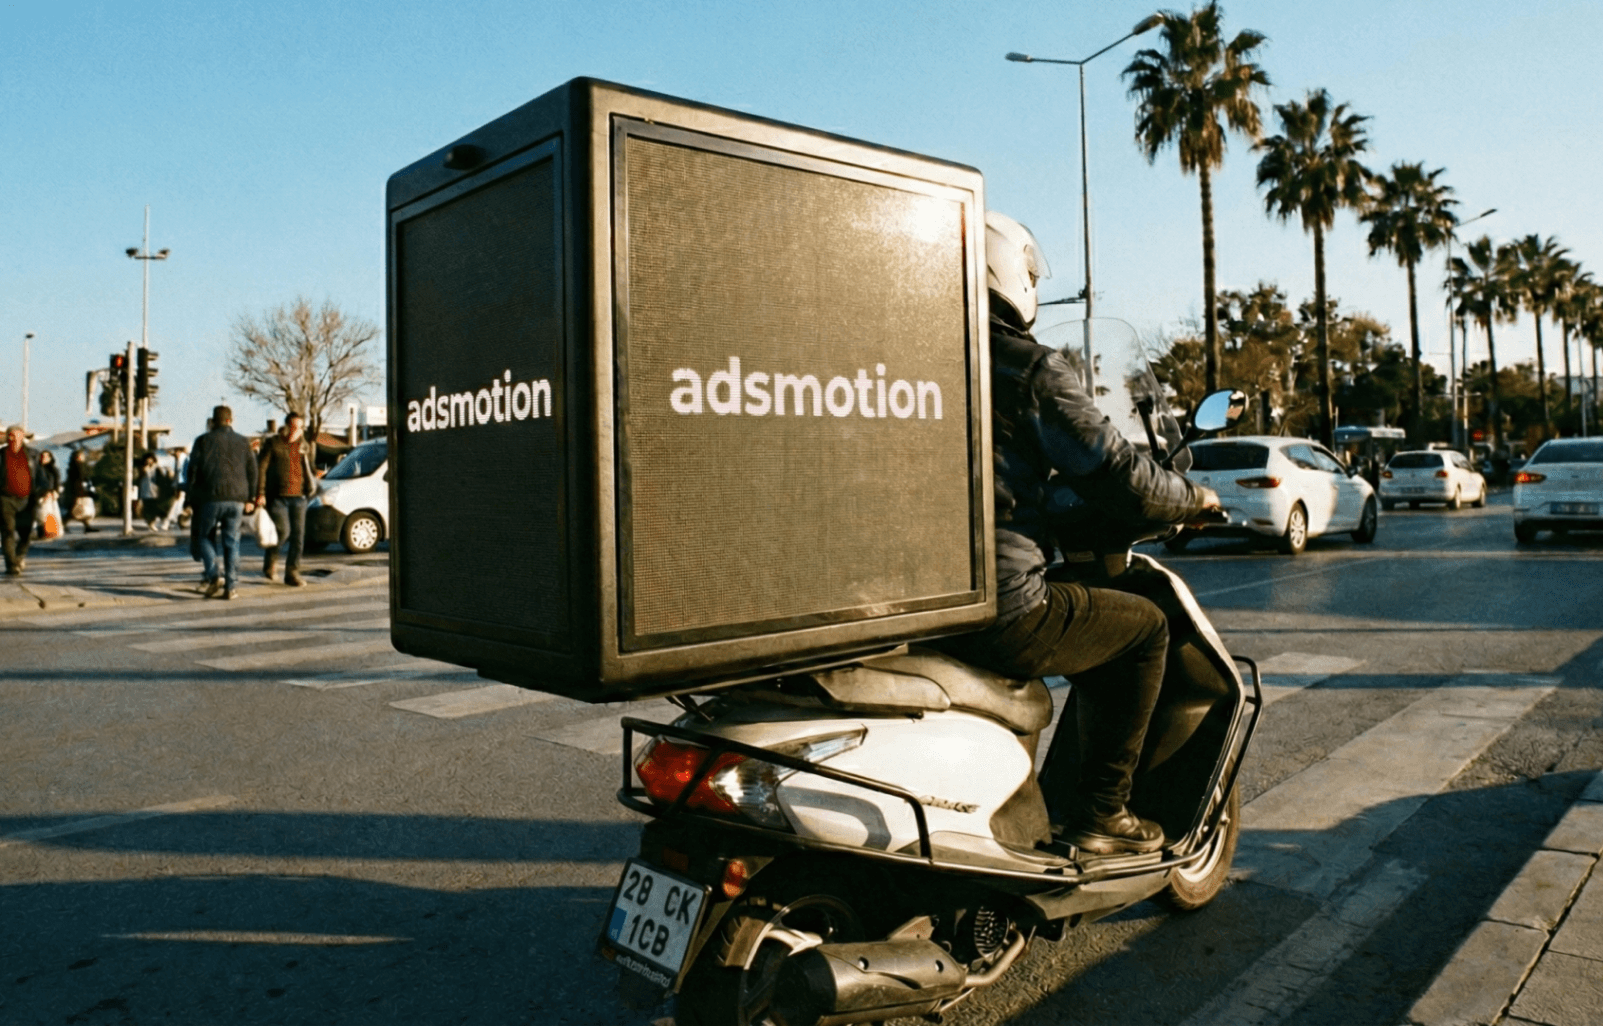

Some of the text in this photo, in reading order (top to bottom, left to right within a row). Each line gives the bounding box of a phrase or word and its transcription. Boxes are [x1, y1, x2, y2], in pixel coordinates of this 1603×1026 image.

[407, 370, 552, 432] adsmotion
[670, 357, 942, 420] adsmotion
[623, 870, 697, 925] 28 CK
[628, 914, 669, 957] 1CB
